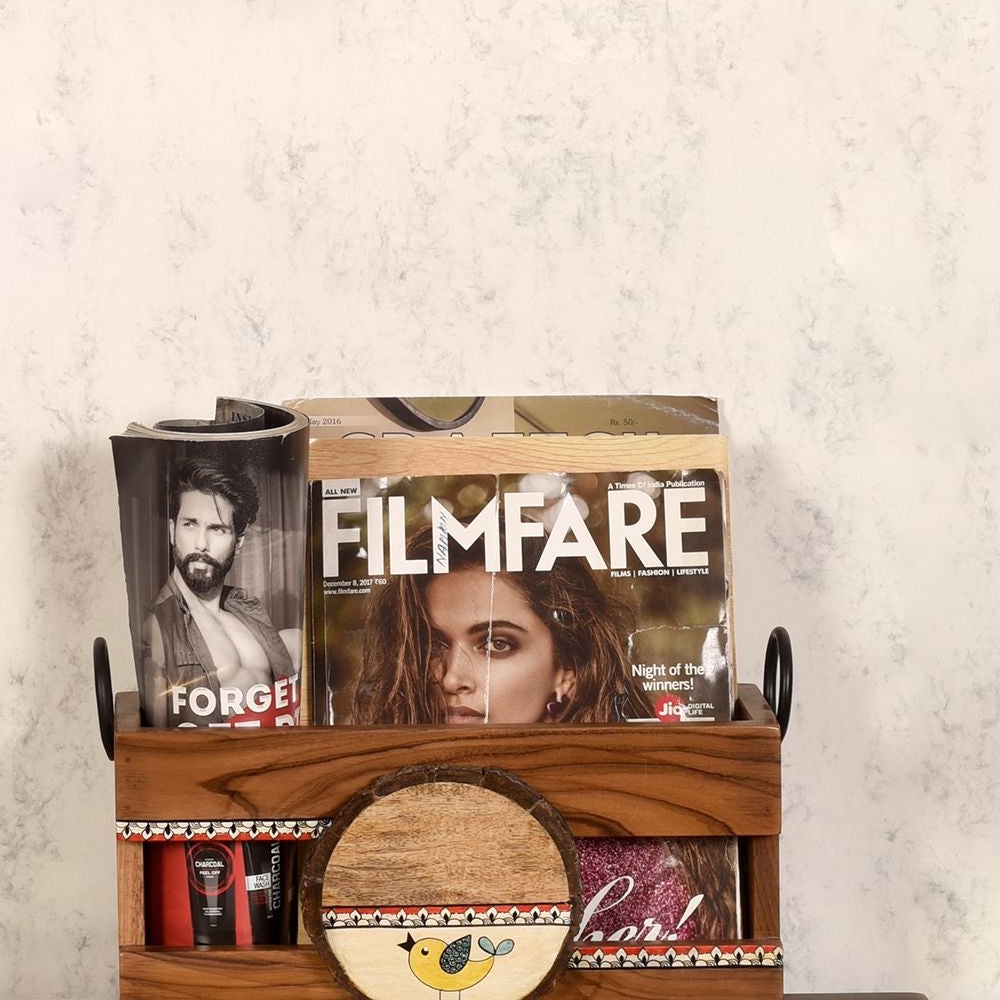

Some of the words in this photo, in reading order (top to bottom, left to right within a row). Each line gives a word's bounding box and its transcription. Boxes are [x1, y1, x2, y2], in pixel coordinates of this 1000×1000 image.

[322, 417, 342, 425] 2016
[647, 480, 664, 488] India
[666, 479, 705, 488] Publication
[340, 487, 358, 495] NEW
[322, 487, 709, 578] FILMFARE
[610, 570, 632, 578] FILMS
[323, 580, 351, 588] December
[631, 664, 666, 679] Night
[669, 663, 681, 676] of
[684, 663, 705, 676] the
[643, 678, 694, 691] winners!
[172, 673, 299, 716] FORGET
[659, 701, 682, 716] Jio
[194, 860, 225, 868] CHARCOAL
[255, 874, 270, 883] FACE
[253, 881, 270, 889] WASH
